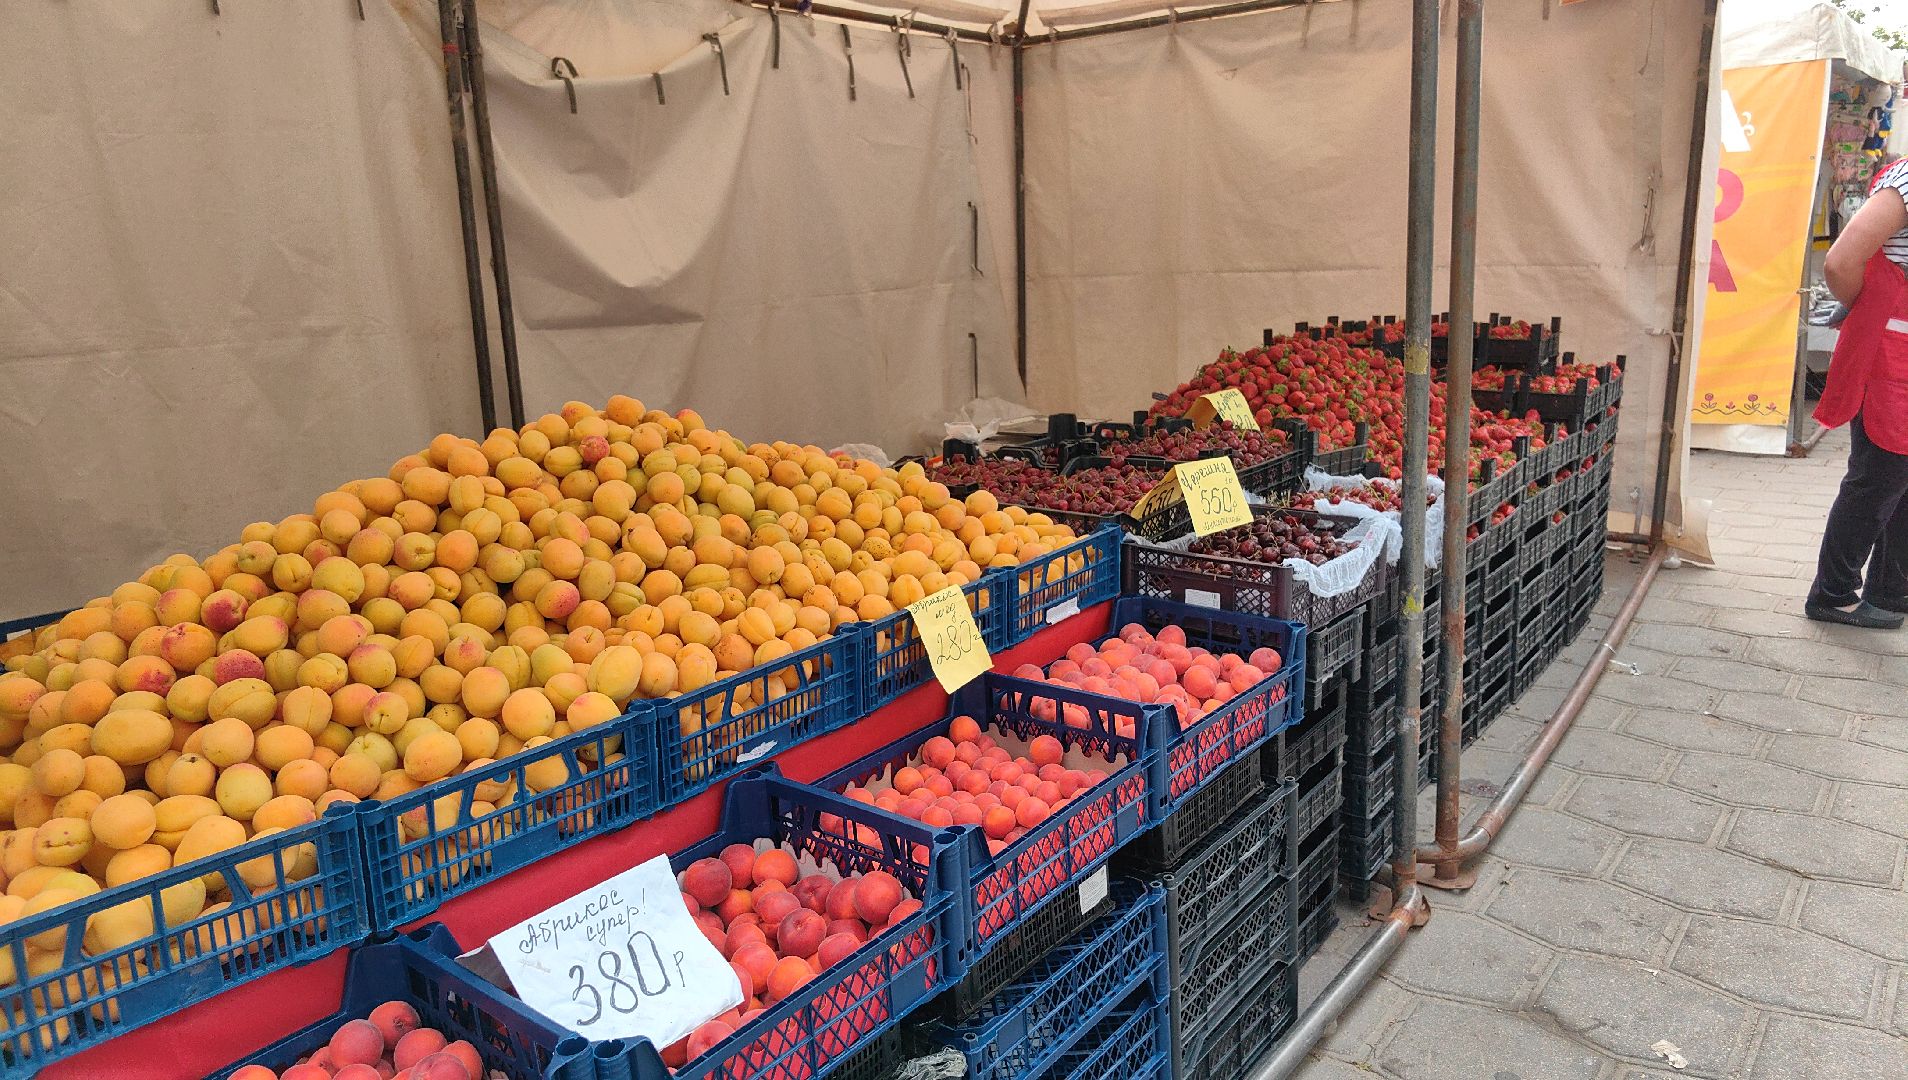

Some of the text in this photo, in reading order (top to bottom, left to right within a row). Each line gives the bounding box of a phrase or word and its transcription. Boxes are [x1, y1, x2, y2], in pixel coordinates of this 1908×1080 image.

[1200, 487, 1232, 515] 550
[936, 619, 972, 665] 280
[519, 889, 624, 954] Абрикос
[569, 931, 671, 1025] 380
